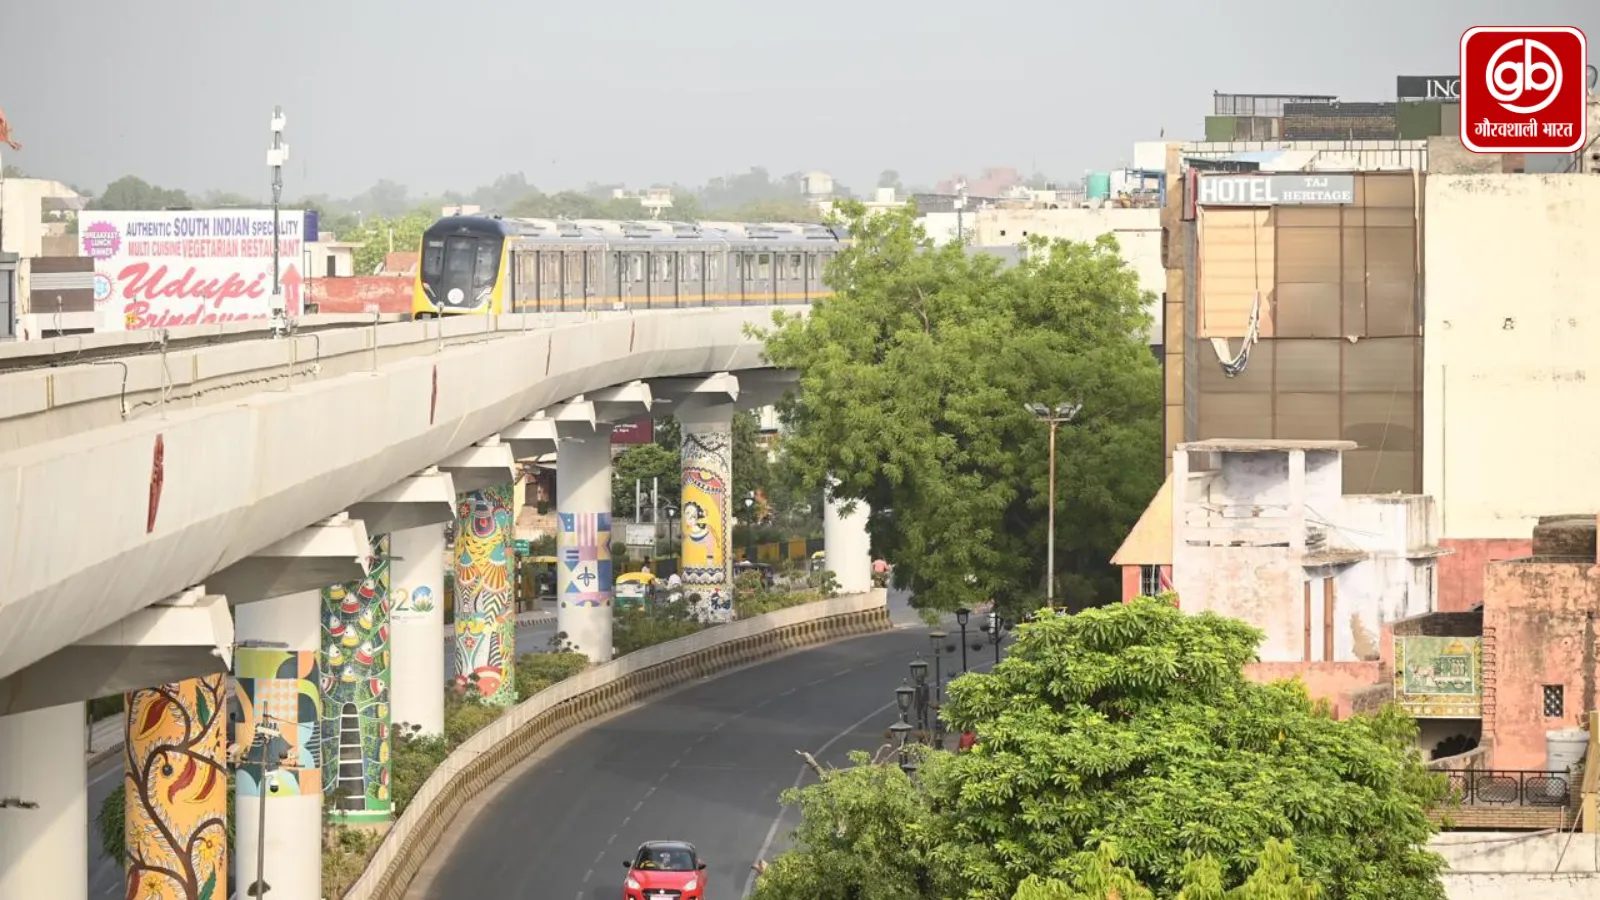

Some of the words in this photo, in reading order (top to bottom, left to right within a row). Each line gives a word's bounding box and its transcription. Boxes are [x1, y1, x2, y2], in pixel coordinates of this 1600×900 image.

[1200, 177, 1279, 202] HOTEL
[1304, 177, 1328, 188] TAJ
[1283, 190, 1351, 201] HERITAGE
[126, 221, 172, 237] AUTHENTIC
[173, 217, 210, 237] SOUTH
[213, 216, 250, 236] INDIAN
[251, 221, 299, 236] SPECALITY
[128, 241, 150, 257] MULTI
[151, 241, 181, 256] CUISINE
[182, 239, 239, 258] VEGETARIAN
[240, 239, 301, 258] RESTAURANT
[117, 262, 266, 309] Udupi
